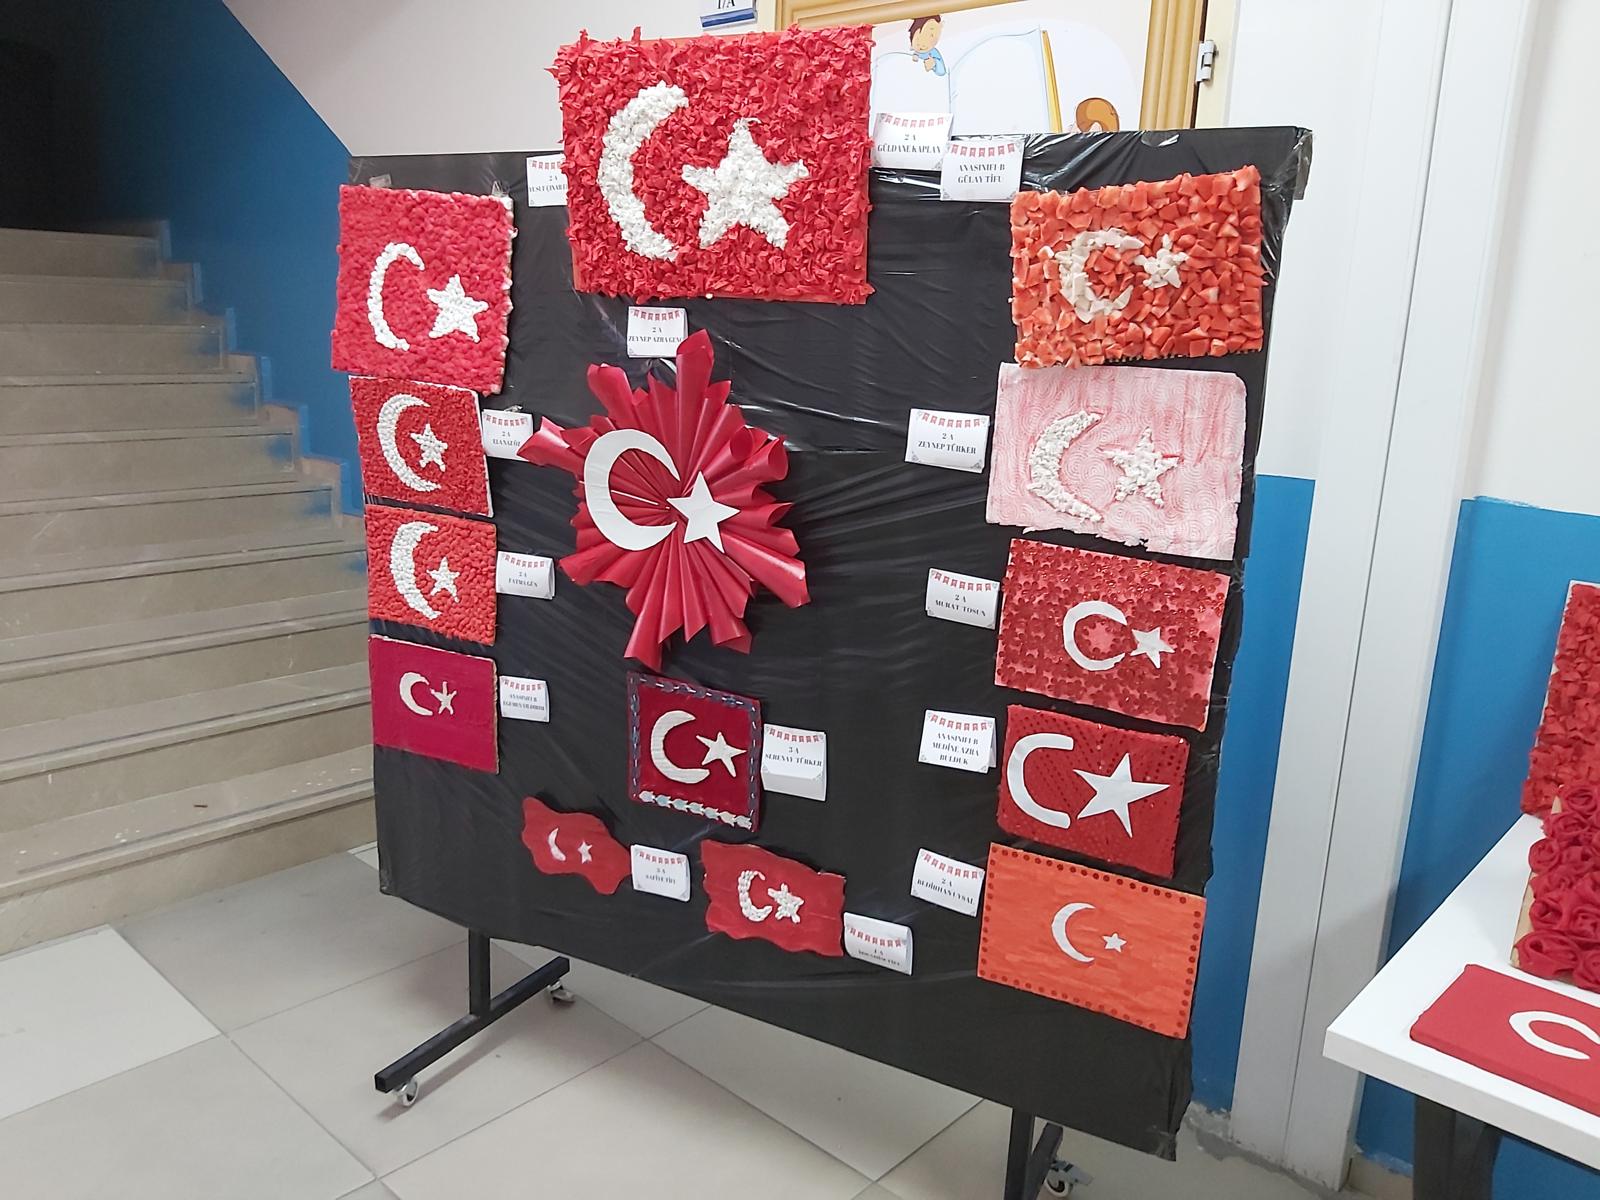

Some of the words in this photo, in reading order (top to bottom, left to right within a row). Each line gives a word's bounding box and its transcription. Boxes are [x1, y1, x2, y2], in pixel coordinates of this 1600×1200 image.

[878, 143, 910, 152] GÜLDANE
[912, 145, 941, 153] KAPLAN
[958, 174, 982, 183] GÜLAY
[918, 440, 945, 450] ZEYNEP
[947, 443, 976, 454] TÜRKER
[936, 600, 959, 610] MURAT
[796, 757, 822, 766] TÜRKER
